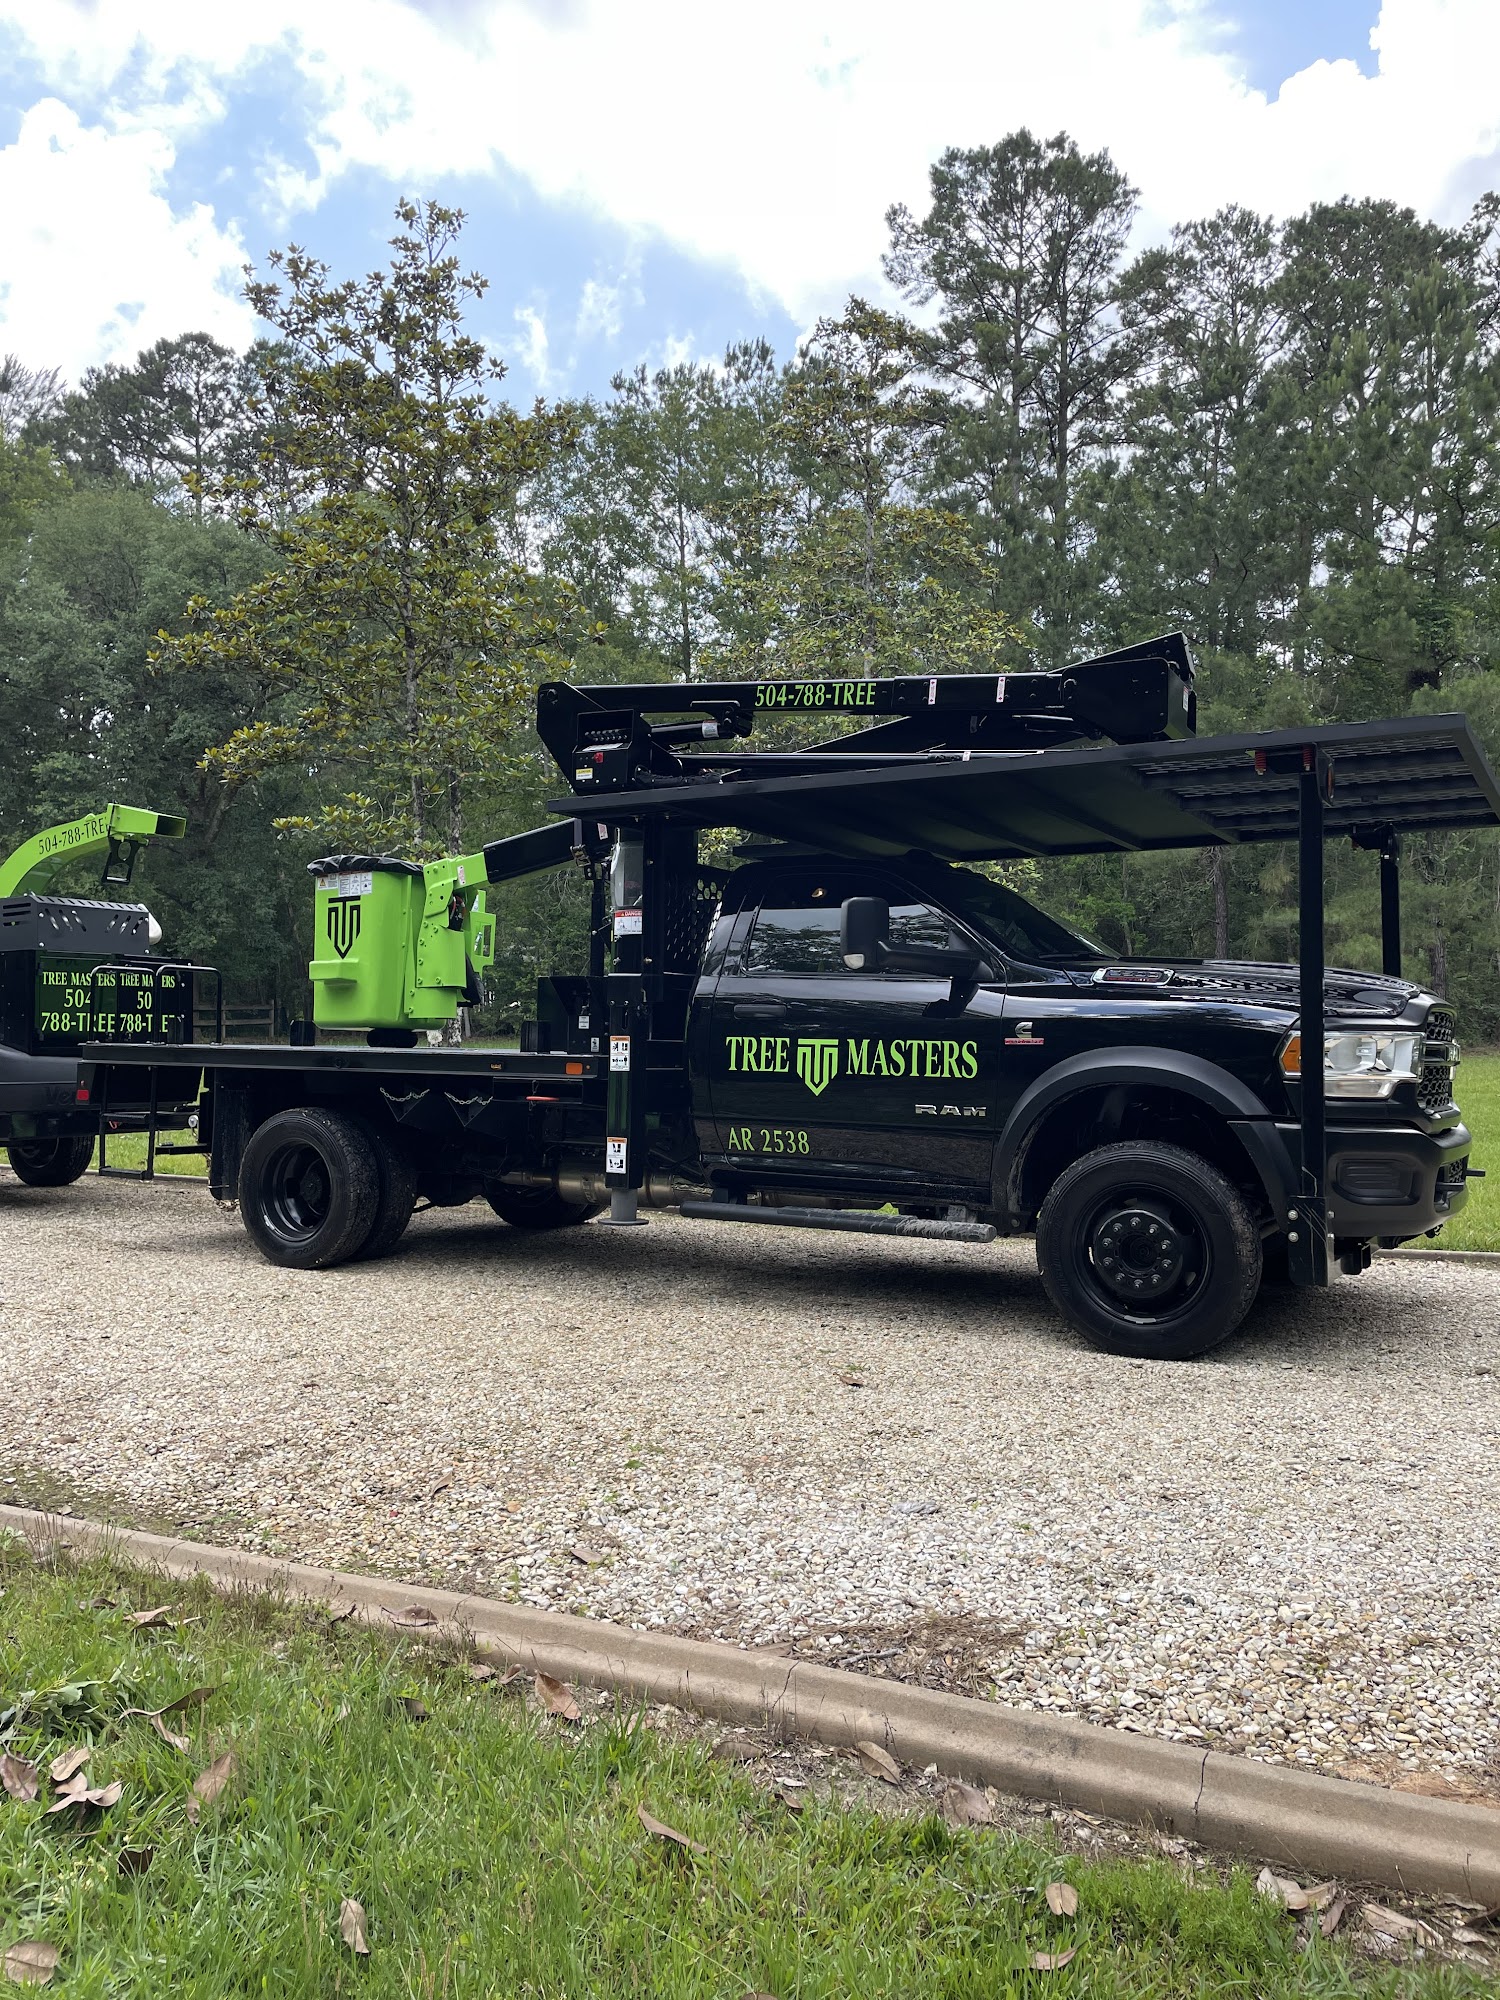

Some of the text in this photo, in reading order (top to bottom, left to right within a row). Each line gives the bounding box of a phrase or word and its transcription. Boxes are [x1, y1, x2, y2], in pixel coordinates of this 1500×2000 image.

[754, 682, 877, 707] 504-788-TREE
[38, 817, 109, 855] 504-788-TRE
[42, 971, 68, 985] TREE
[120, 973, 176, 988] TREE MAERS
[137, 991, 152, 1010] 50
[120, 1013, 175, 1033] 788-TE
[725, 1036, 790, 1073] TREE
[846, 1038, 979, 1079] MASTERS
[914, 1103, 987, 1117] RAM
[728, 1127, 811, 1155] AR 2538
